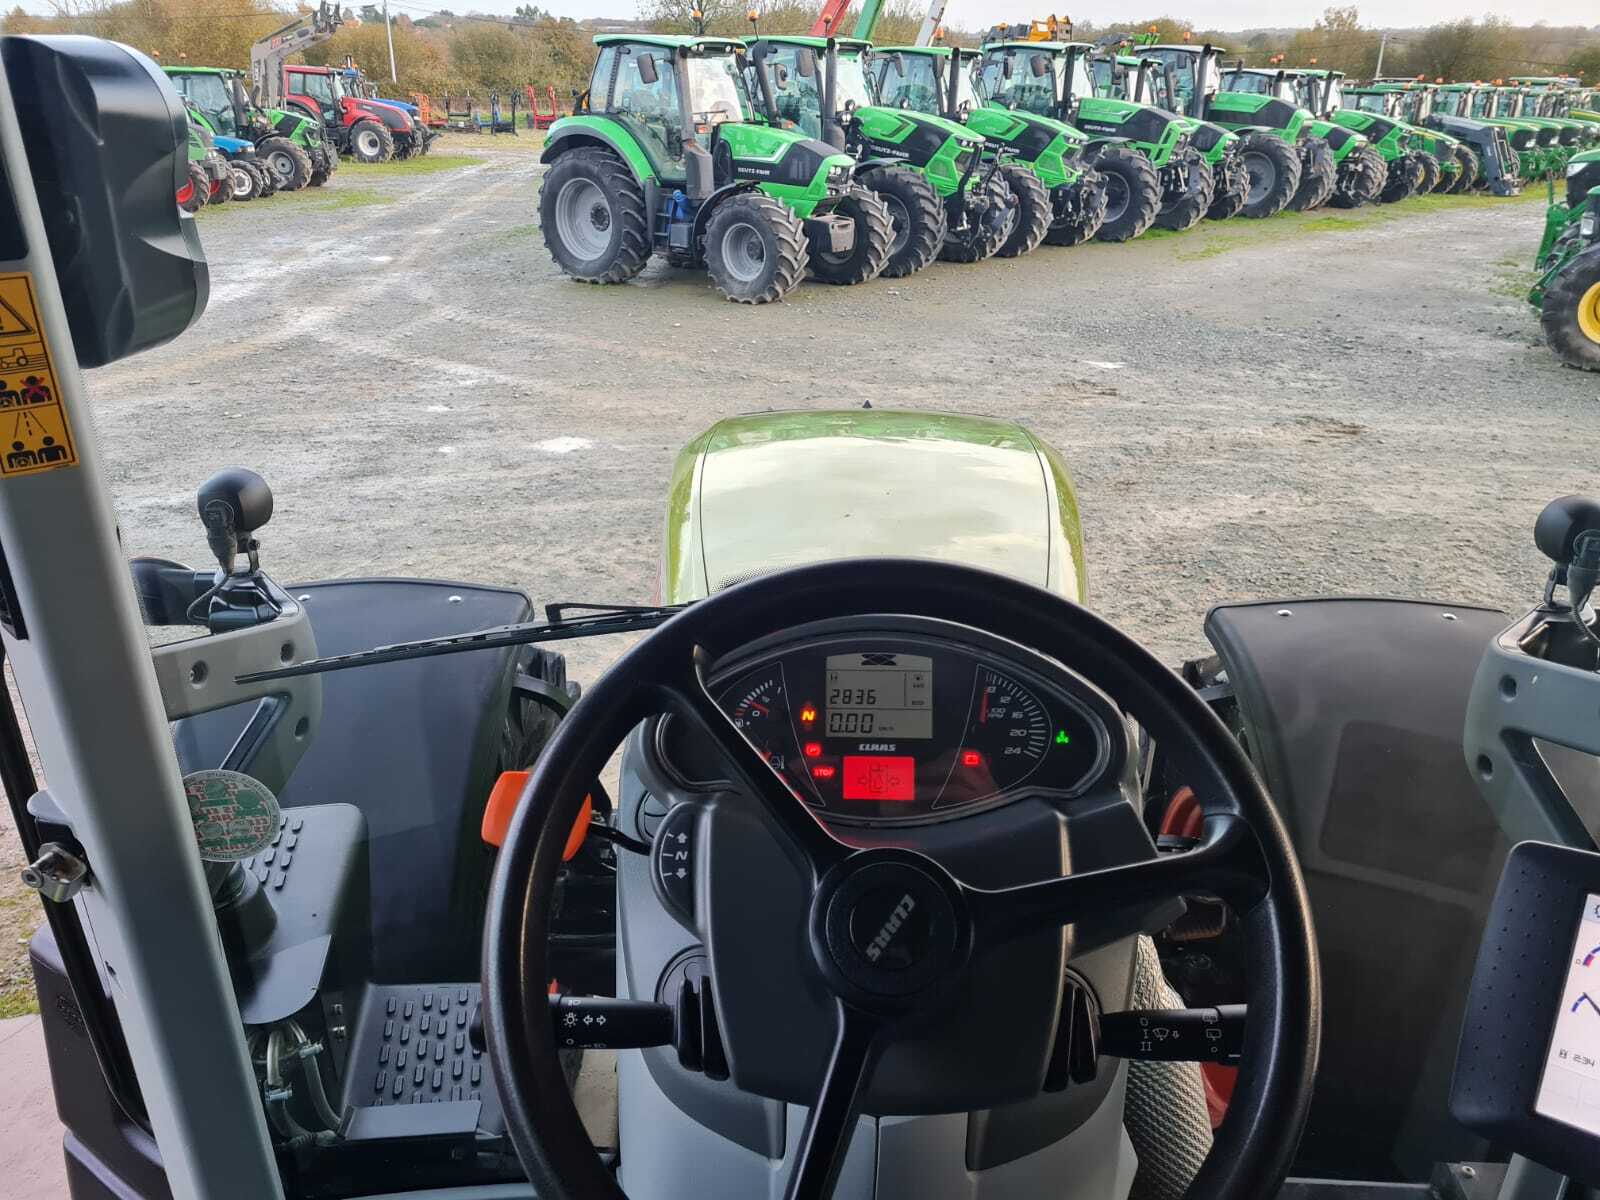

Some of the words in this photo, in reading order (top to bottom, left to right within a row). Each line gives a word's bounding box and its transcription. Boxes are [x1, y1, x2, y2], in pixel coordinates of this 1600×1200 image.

[829, 688, 877, 705] 2836
[801, 710, 816, 721] N
[829, 713, 874, 734] 0.00
[858, 743, 897, 752] CLAAS
[814, 766, 834, 776] STOP
[674, 851, 688, 860] N
[866, 894, 915, 962] CLAAS
